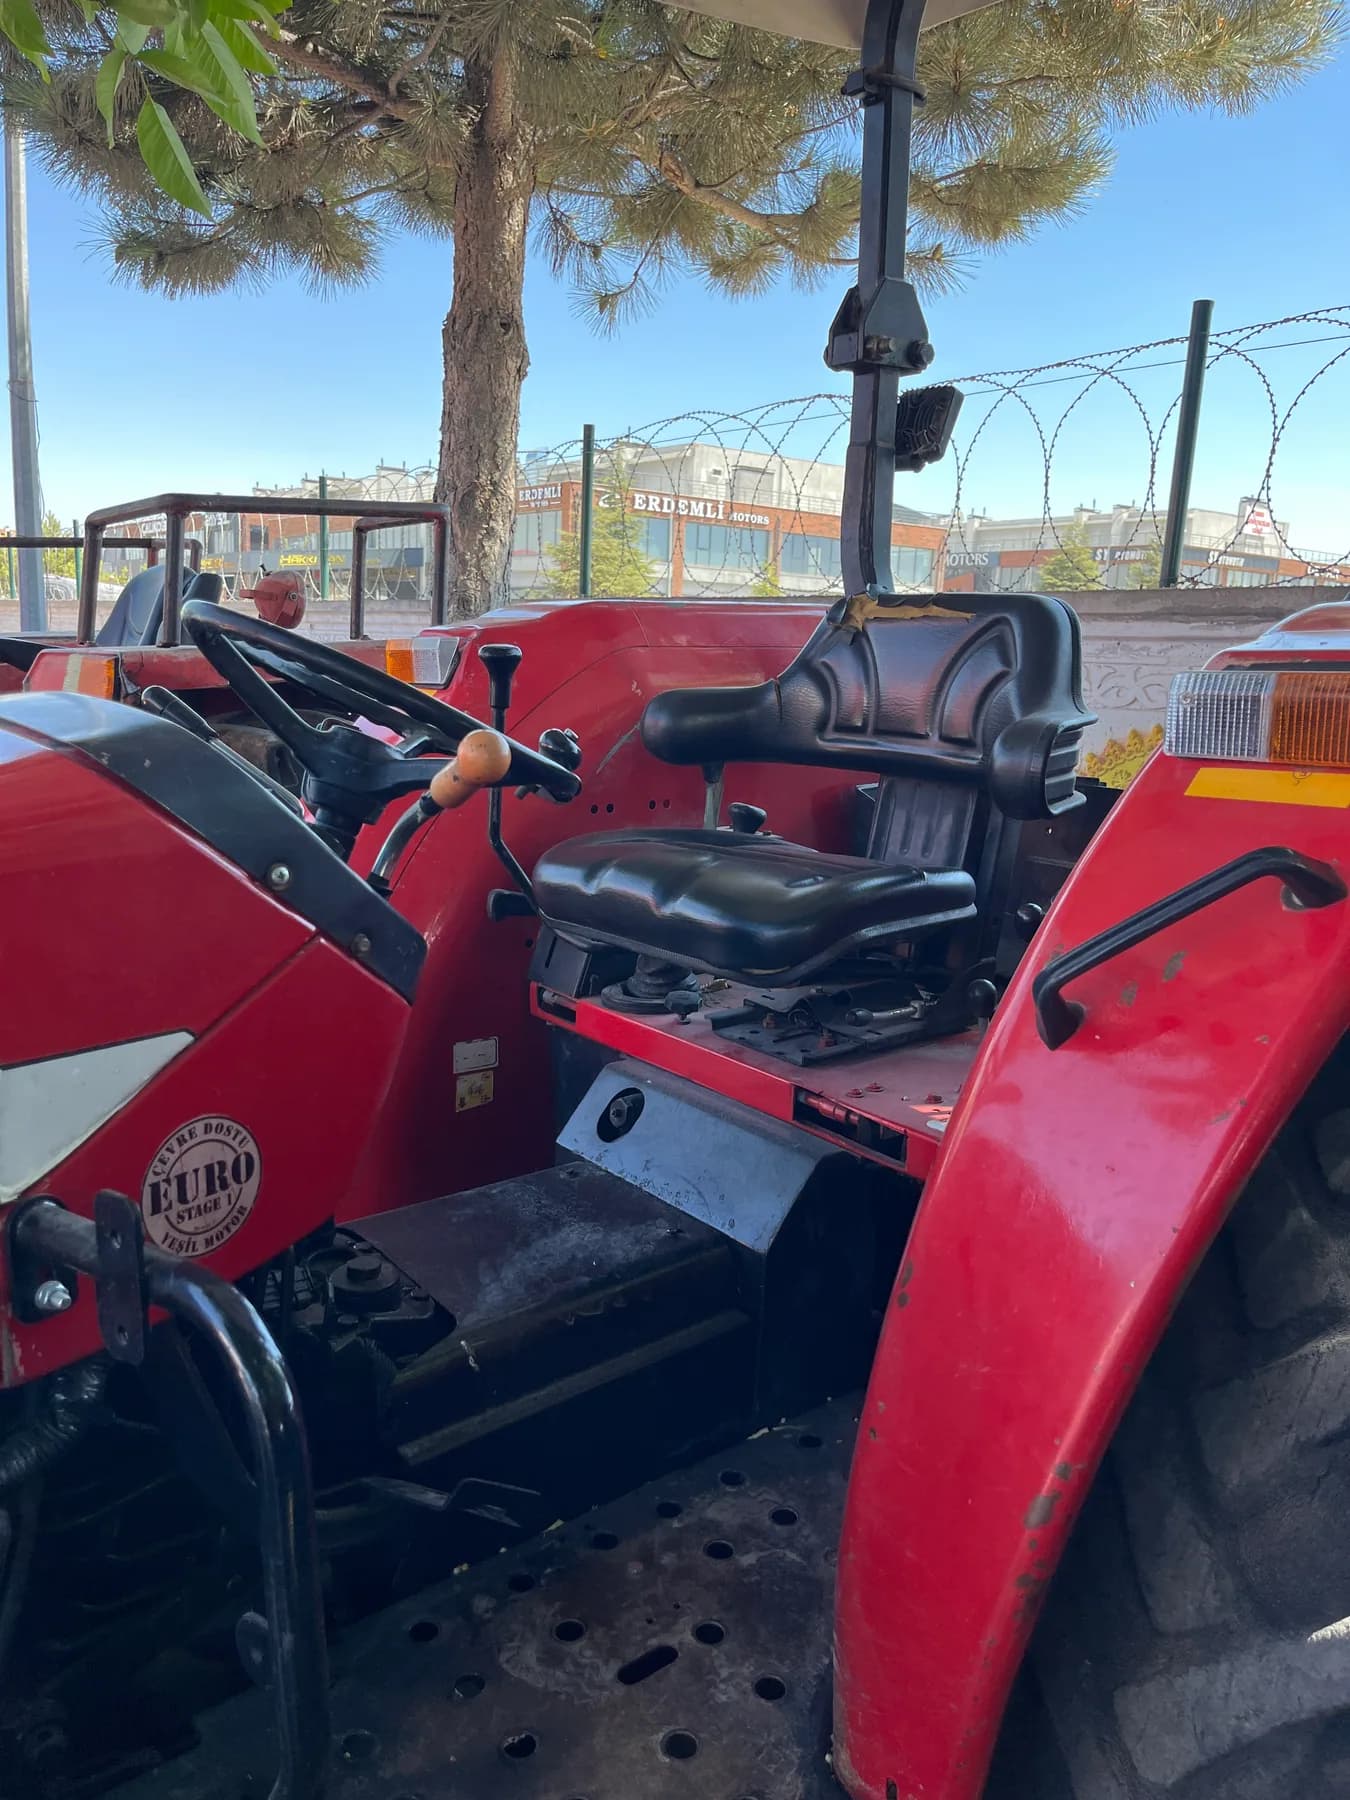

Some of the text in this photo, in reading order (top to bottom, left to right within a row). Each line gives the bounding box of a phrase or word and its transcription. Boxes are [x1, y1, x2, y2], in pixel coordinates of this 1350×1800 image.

[633, 493, 725, 520] ERDEMLİ
[203, 1122, 251, 1149] DOSTU
[149, 1151, 255, 1217] EURO
[176, 1197, 222, 1225] STAGE
[161, 1205, 249, 1254] YEŞİL MOTOR
